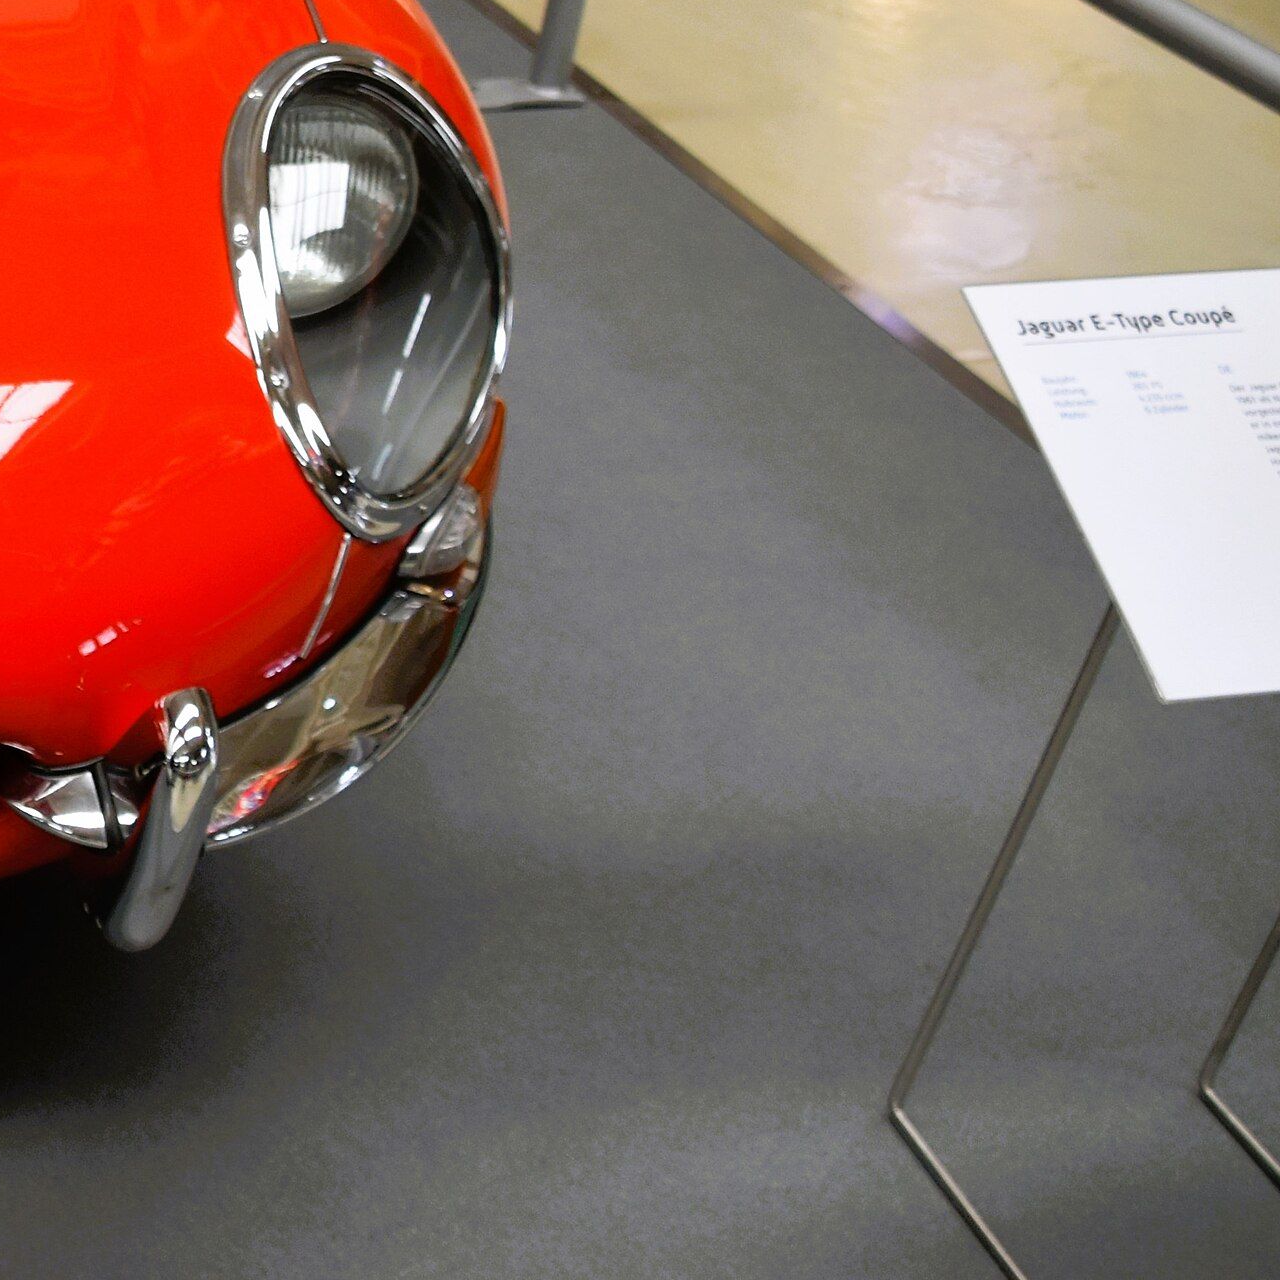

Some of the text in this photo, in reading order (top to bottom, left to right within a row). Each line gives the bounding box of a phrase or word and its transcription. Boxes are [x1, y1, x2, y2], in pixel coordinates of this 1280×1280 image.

[1017, 305, 1236, 339] Jaguar E-Type Coupé
